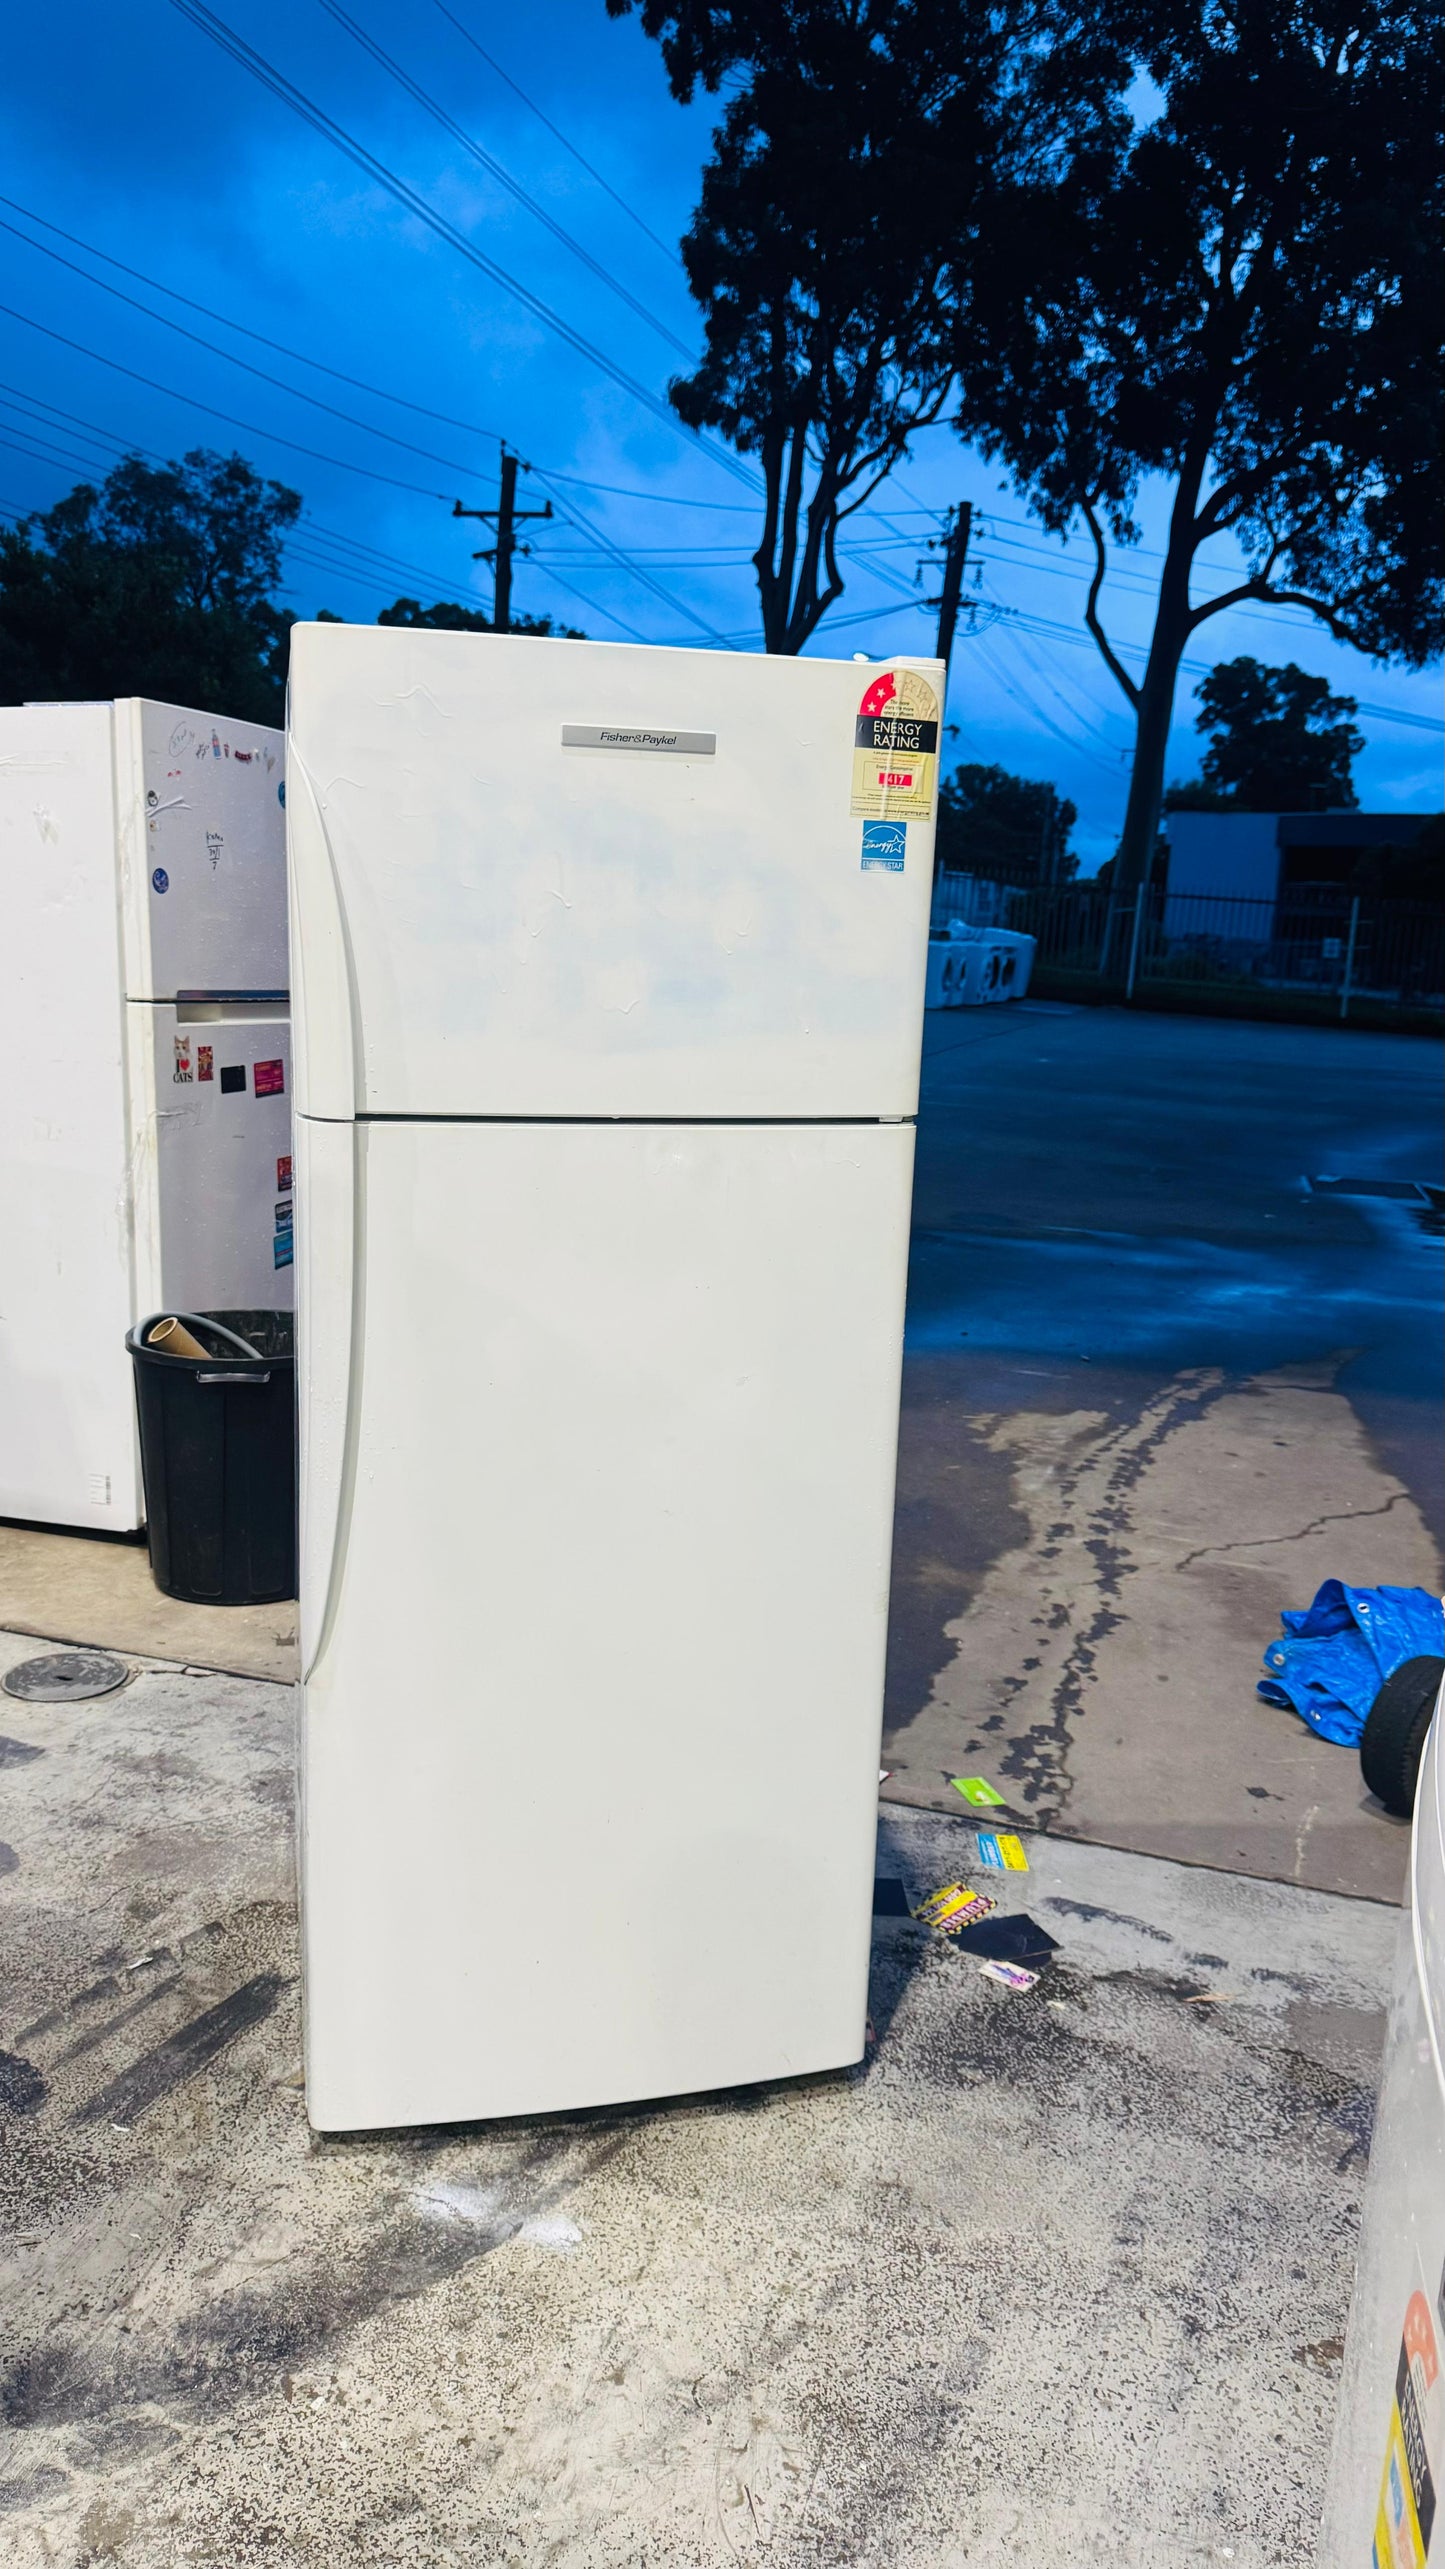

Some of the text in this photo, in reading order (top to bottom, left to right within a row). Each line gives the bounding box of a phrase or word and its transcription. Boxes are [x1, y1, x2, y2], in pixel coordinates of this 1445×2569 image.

[873, 720, 922, 736] ENERGY
[600, 731, 677, 747] Fisher&Paykel
[873, 735, 920, 749] RATING
[887, 774, 905, 785] 417
[887, 862, 903, 871] STAR
[173, 1071, 193, 1084] CATS
